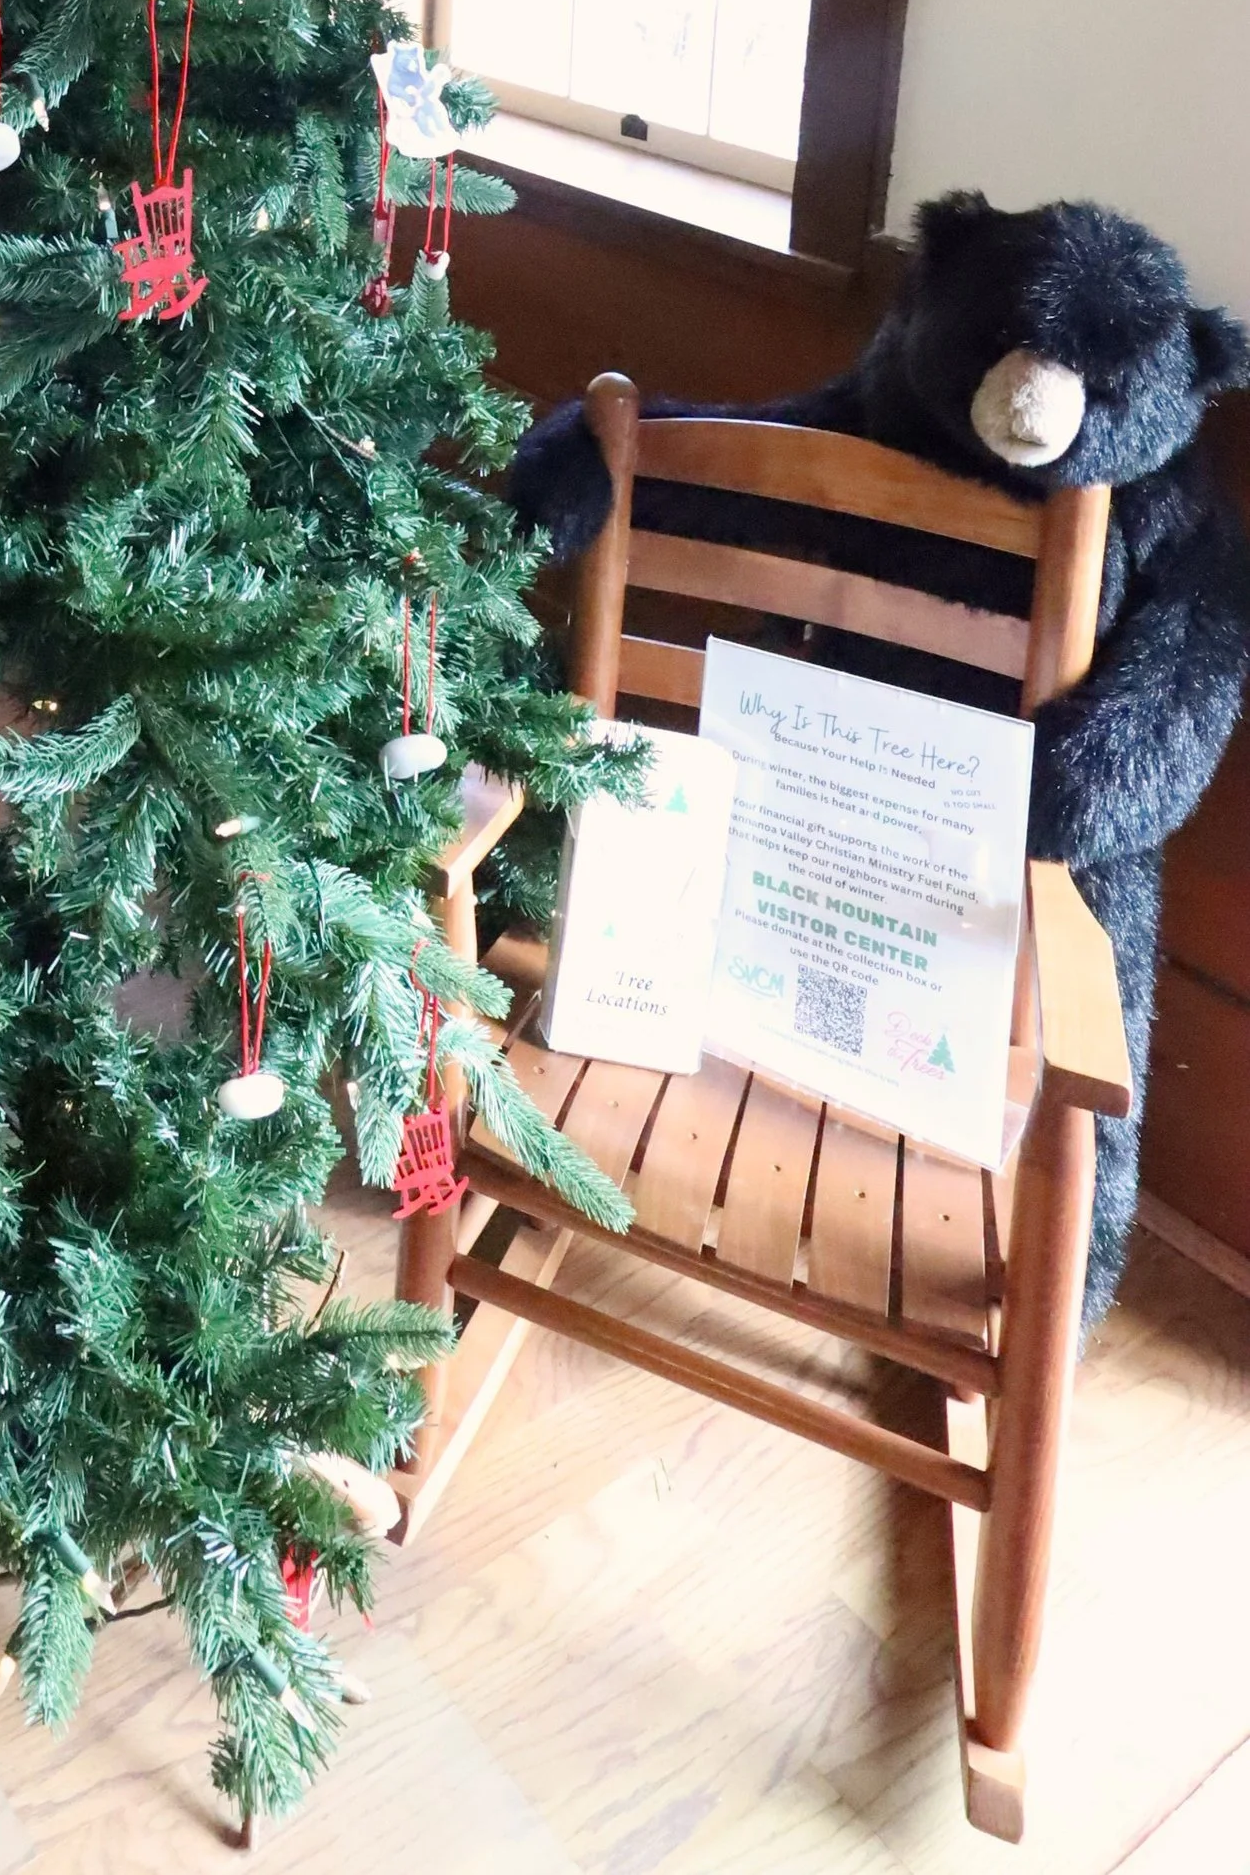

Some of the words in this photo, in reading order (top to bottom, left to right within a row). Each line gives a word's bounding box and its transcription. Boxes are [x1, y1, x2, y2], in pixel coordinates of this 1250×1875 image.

[739, 690, 788, 734] Why
[791, 704, 812, 731] Is
[817, 712, 863, 745] This
[868, 726, 915, 760] Tree
[920, 741, 981, 783] Here?
[774, 731, 820, 754] Because
[822, 746, 847, 763] Your
[850, 755, 876, 774] Help
[891, 767, 937, 790] Needed
[731, 749, 766, 772] During
[769, 762, 807, 783] winter,
[808, 773, 828, 789] the
[829, 778, 870, 802] biggest
[872, 794, 920, 817] expense
[921, 808, 940, 824] for
[942, 815, 975, 835] many
[775, 778, 818, 801] families
[820, 789, 829, 804] is
[831, 793, 857, 813] heat
[858, 805, 881, 821] and
[882, 813, 923, 835] power.
[727, 826, 750, 842] that
[751, 832, 782, 852] helps
[782, 843, 810, 863] keep
[811, 854, 830, 868] our
[831, 860, 888, 889] neighbors
[891, 882, 924, 900] warm
[925, 892, 965, 917] during
[730, 812, 778, 835] annanoa
[780, 827, 814, 849] Valley
[815, 838, 866, 864] Christian
[868, 857, 916, 882] Ministry
[918, 874, 943, 891] Fuel
[946, 883, 980, 905] Fund,
[732, 796, 758, 813] Your
[759, 805, 805, 828] financial
[807, 818, 827, 836] gift
[828, 828, 878, 853] supports
[881, 844, 900, 860] the
[902, 852, 932, 869] work
[933, 862, 947, 875] of
[948, 866, 969, 882] the
[752, 869, 819, 906] BLACK
[825, 895, 938, 948] MOUNTAIN
[787, 861, 806, 876] the
[808, 869, 833, 886] cold
[834, 877, 848, 890] of
[848, 882, 888, 905] winter.
[734, 907, 769, 930] Please
[771, 922, 810, 945] donate
[811, 937, 824, 950] at
[825, 940, 845, 957] the
[846, 949, 903, 979] collection
[905, 969, 928, 987] box
[930, 980, 943, 993] or
[756, 898, 839, 940] VISITOR
[843, 930, 929, 973] CENTER
[789, 945, 809, 960] use
[811, 951, 831, 968] the
[832, 960, 850, 975] QR
[851, 968, 879, 986] code
[584, 987, 669, 1016] Locations
[615, 970, 653, 991] Tree
[727, 955, 786, 999] SVCM
